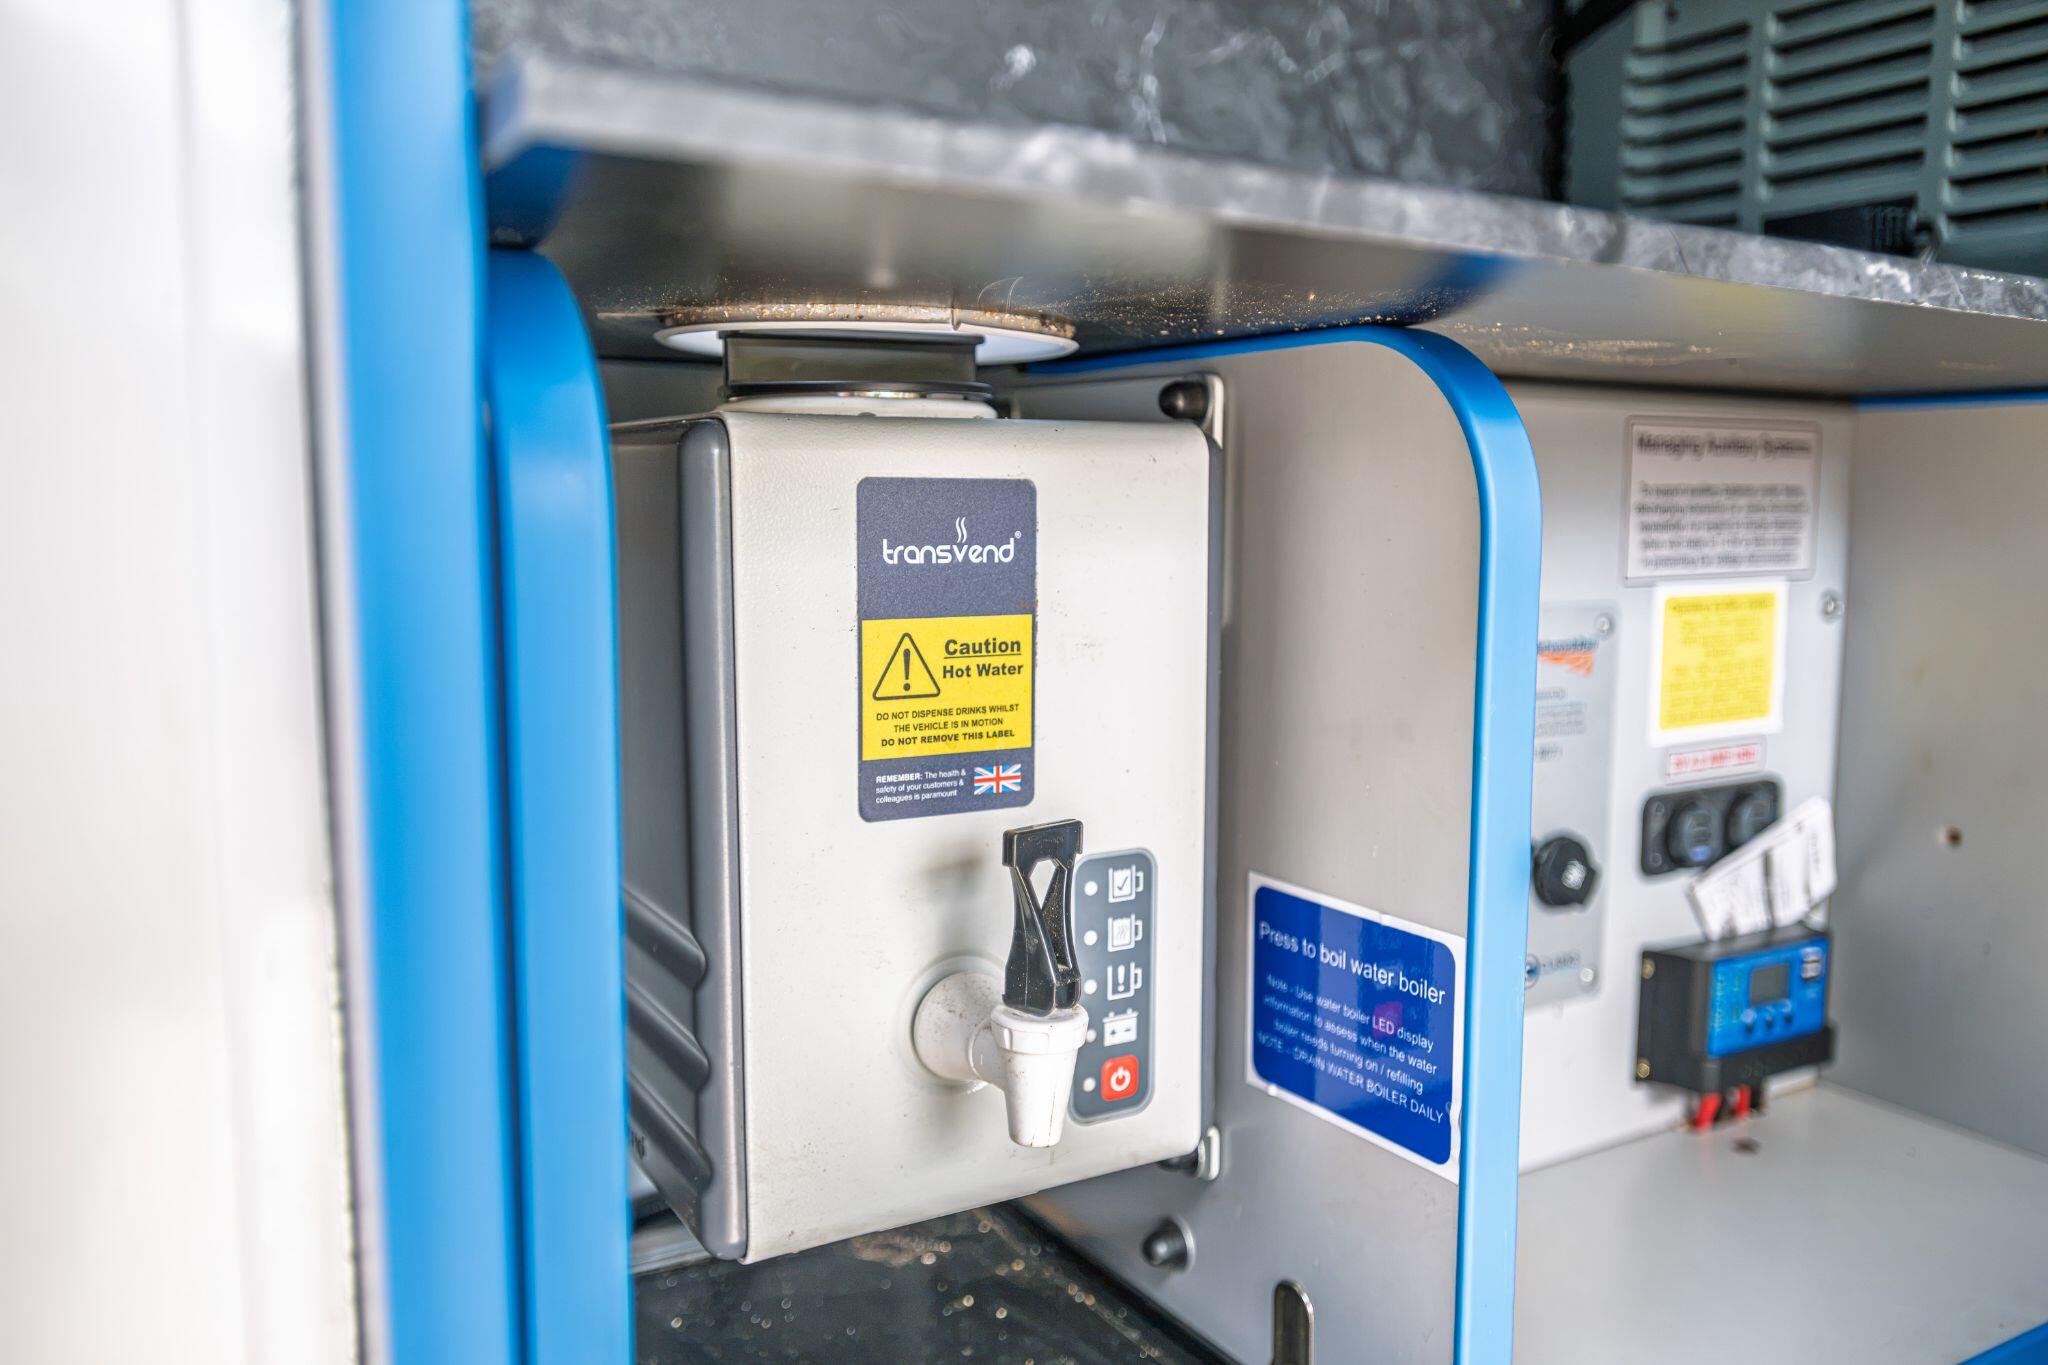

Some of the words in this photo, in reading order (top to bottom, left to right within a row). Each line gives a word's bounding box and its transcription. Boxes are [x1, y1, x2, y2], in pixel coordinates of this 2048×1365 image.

[944, 637, 1021, 656] Caution
[943, 665, 971, 679] Hot
[976, 663, 1023, 677] Water
[876, 712, 889, 721] DO
[892, 711, 909, 720] NOT
[912, 708, 953, 719] DISPENSE
[956, 705, 987, 716] DRINKS
[989, 703, 1019, 713] WHILST
[894, 723, 910, 733] THE
[913, 721, 948, 732] VEHICLE
[951, 720, 958, 729] IS
[961, 719, 969, 728] IN
[971, 717, 1003, 727] MOTION
[881, 738, 895, 747] DO
[898, 736, 917, 746] NOT
[920, 733, 959, 744] REMOVE
[962, 731, 983, 741] THIS
[986, 729, 1015, 739] LABEL
[875, 772, 923, 783] REMEMBER:
[924, 771, 938, 779] The
[938, 770, 960, 778] health
[960, 768, 967, 777] &
[875, 784, 897, 794] safety
[898, 783, 905, 792] of
[906, 783, 922, 793] your
[922, 780, 958, 789] customers
[958, 778, 964, 786] &
[875, 794, 913, 804] colleagues
[921, 789, 957, 801] paramount
[1259, 919, 1299, 953] Press
[1302, 937, 1317, 959] to
[1319, 942, 1347, 970] boil
[1350, 957, 1394, 987] water
[1399, 970, 1446, 1005] boiler
[1295, 984, 1314, 1003] Use
[1316, 996, 1342, 1014] water
[1343, 1004, 1371, 1025] boiler
[1372, 1016, 1395, 1035] LED
[1397, 1026, 1434, 1054] display
[1314, 1014, 1323, 1029] to
[1324, 1020, 1358, 1043] assess
[1360, 1032, 1387, 1055] when
[1388, 1044, 1406, 1063] the
[1407, 1053, 1438, 1076] water
[1301, 1032, 1329, 1052] needs
[1329, 1040, 1364, 1070] turning
[1365, 1059, 1378, 1073] on
[1380, 1063, 1385, 1076] /
[1386, 1067, 1424, 1096] refilling
[1293, 1046, 1326, 1071] DRAIN
[1326, 1061, 1364, 1090] WATER
[1366, 1078, 1407, 1108] BOILER
[1410, 1099, 1443, 1125] DAILY
